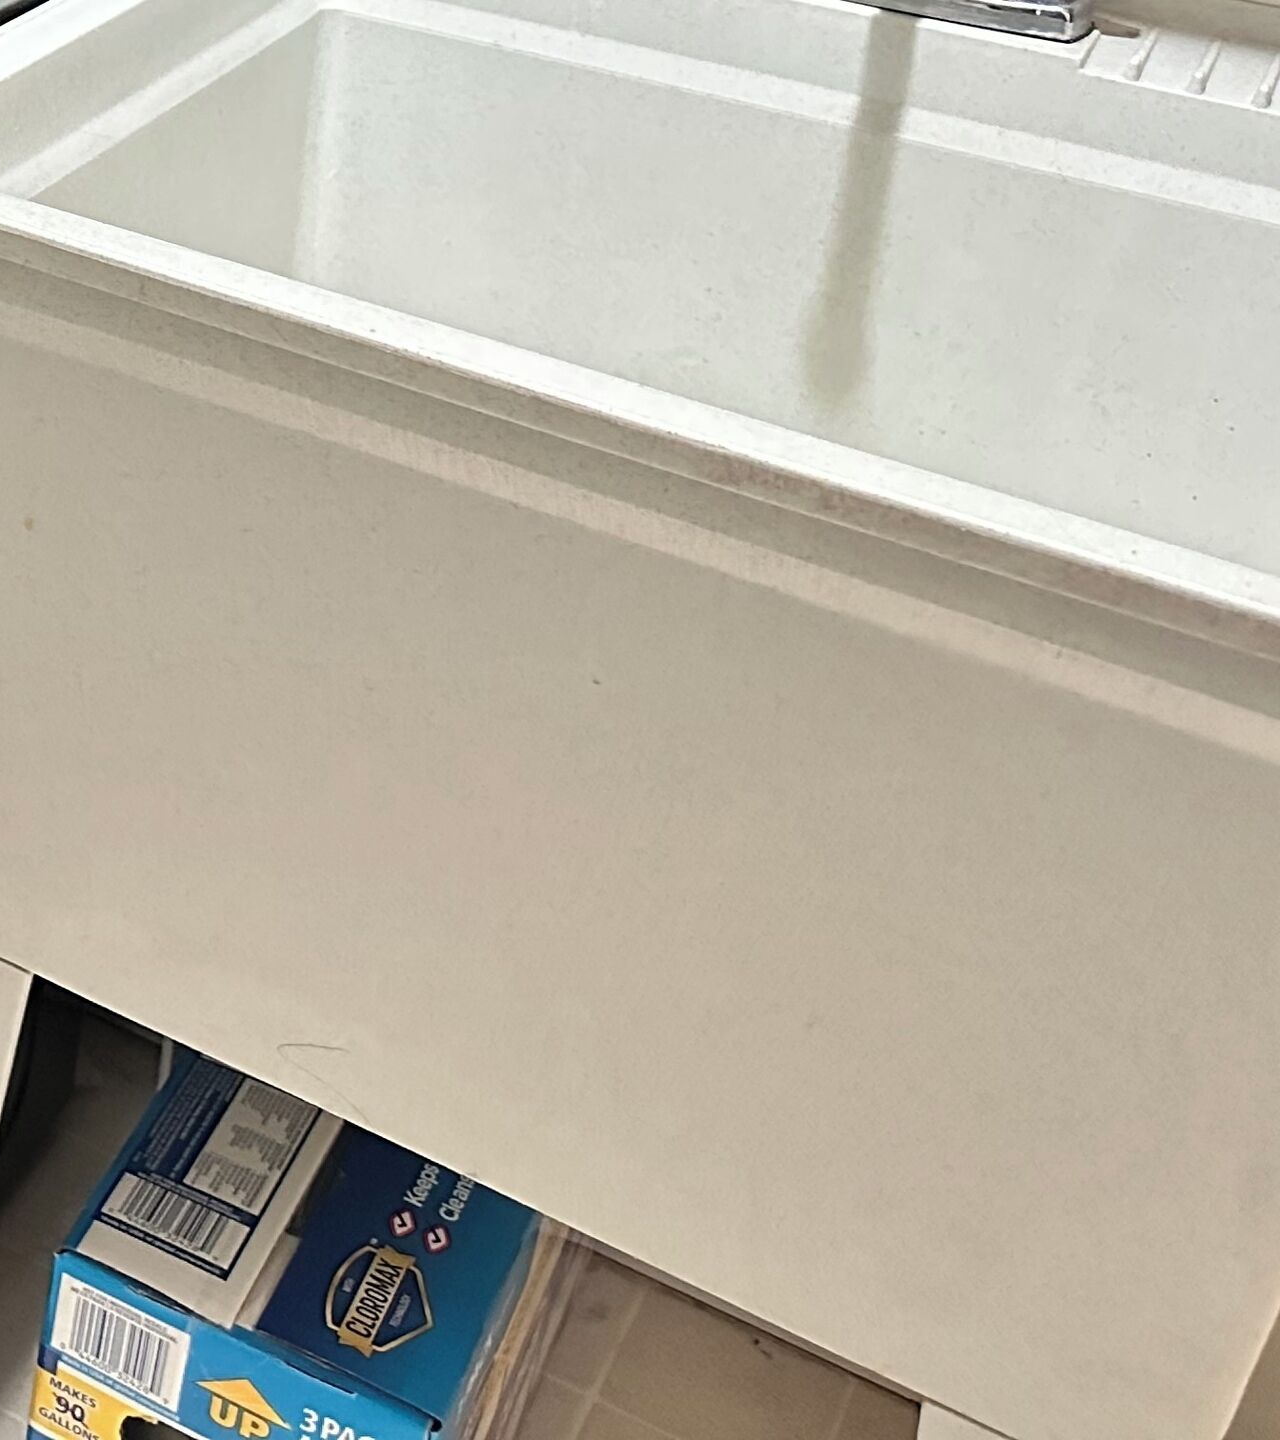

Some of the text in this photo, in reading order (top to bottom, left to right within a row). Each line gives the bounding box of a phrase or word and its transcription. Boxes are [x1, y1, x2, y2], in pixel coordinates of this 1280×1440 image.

[403, 1162, 440, 1208] Keeps
[49, 1377, 97, 1409] MAKES
[54, 1394, 88, 1425] 90
[209, 1394, 270, 1438] UP
[300, 1408, 319, 1433] 3
